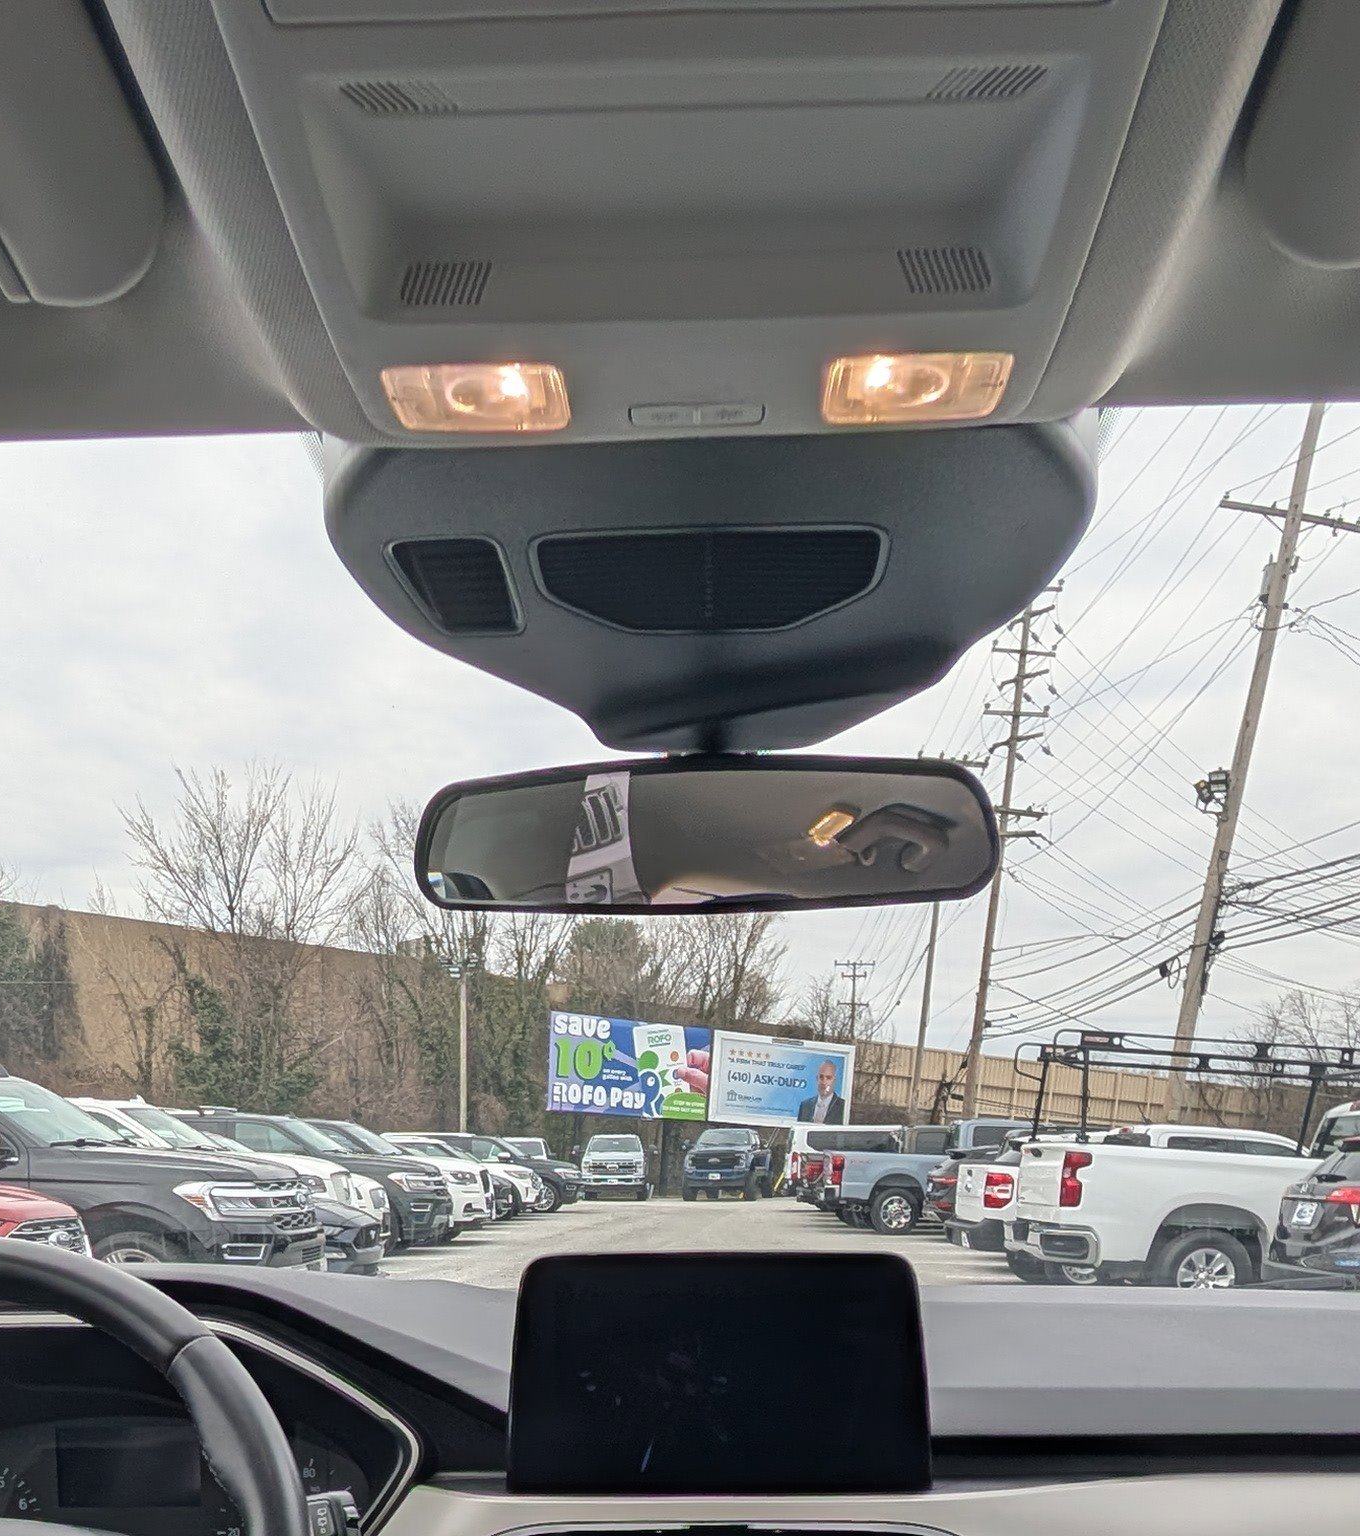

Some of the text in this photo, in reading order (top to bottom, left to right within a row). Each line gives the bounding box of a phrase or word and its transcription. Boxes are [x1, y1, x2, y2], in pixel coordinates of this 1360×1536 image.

[554, 1014, 611, 1039] save
[647, 1034, 672, 1044] ROFO
[727, 1070, 751, 1085] (410)
[610, 1086, 646, 1110] Pay
[18, 1498, 28, 1511] 6
